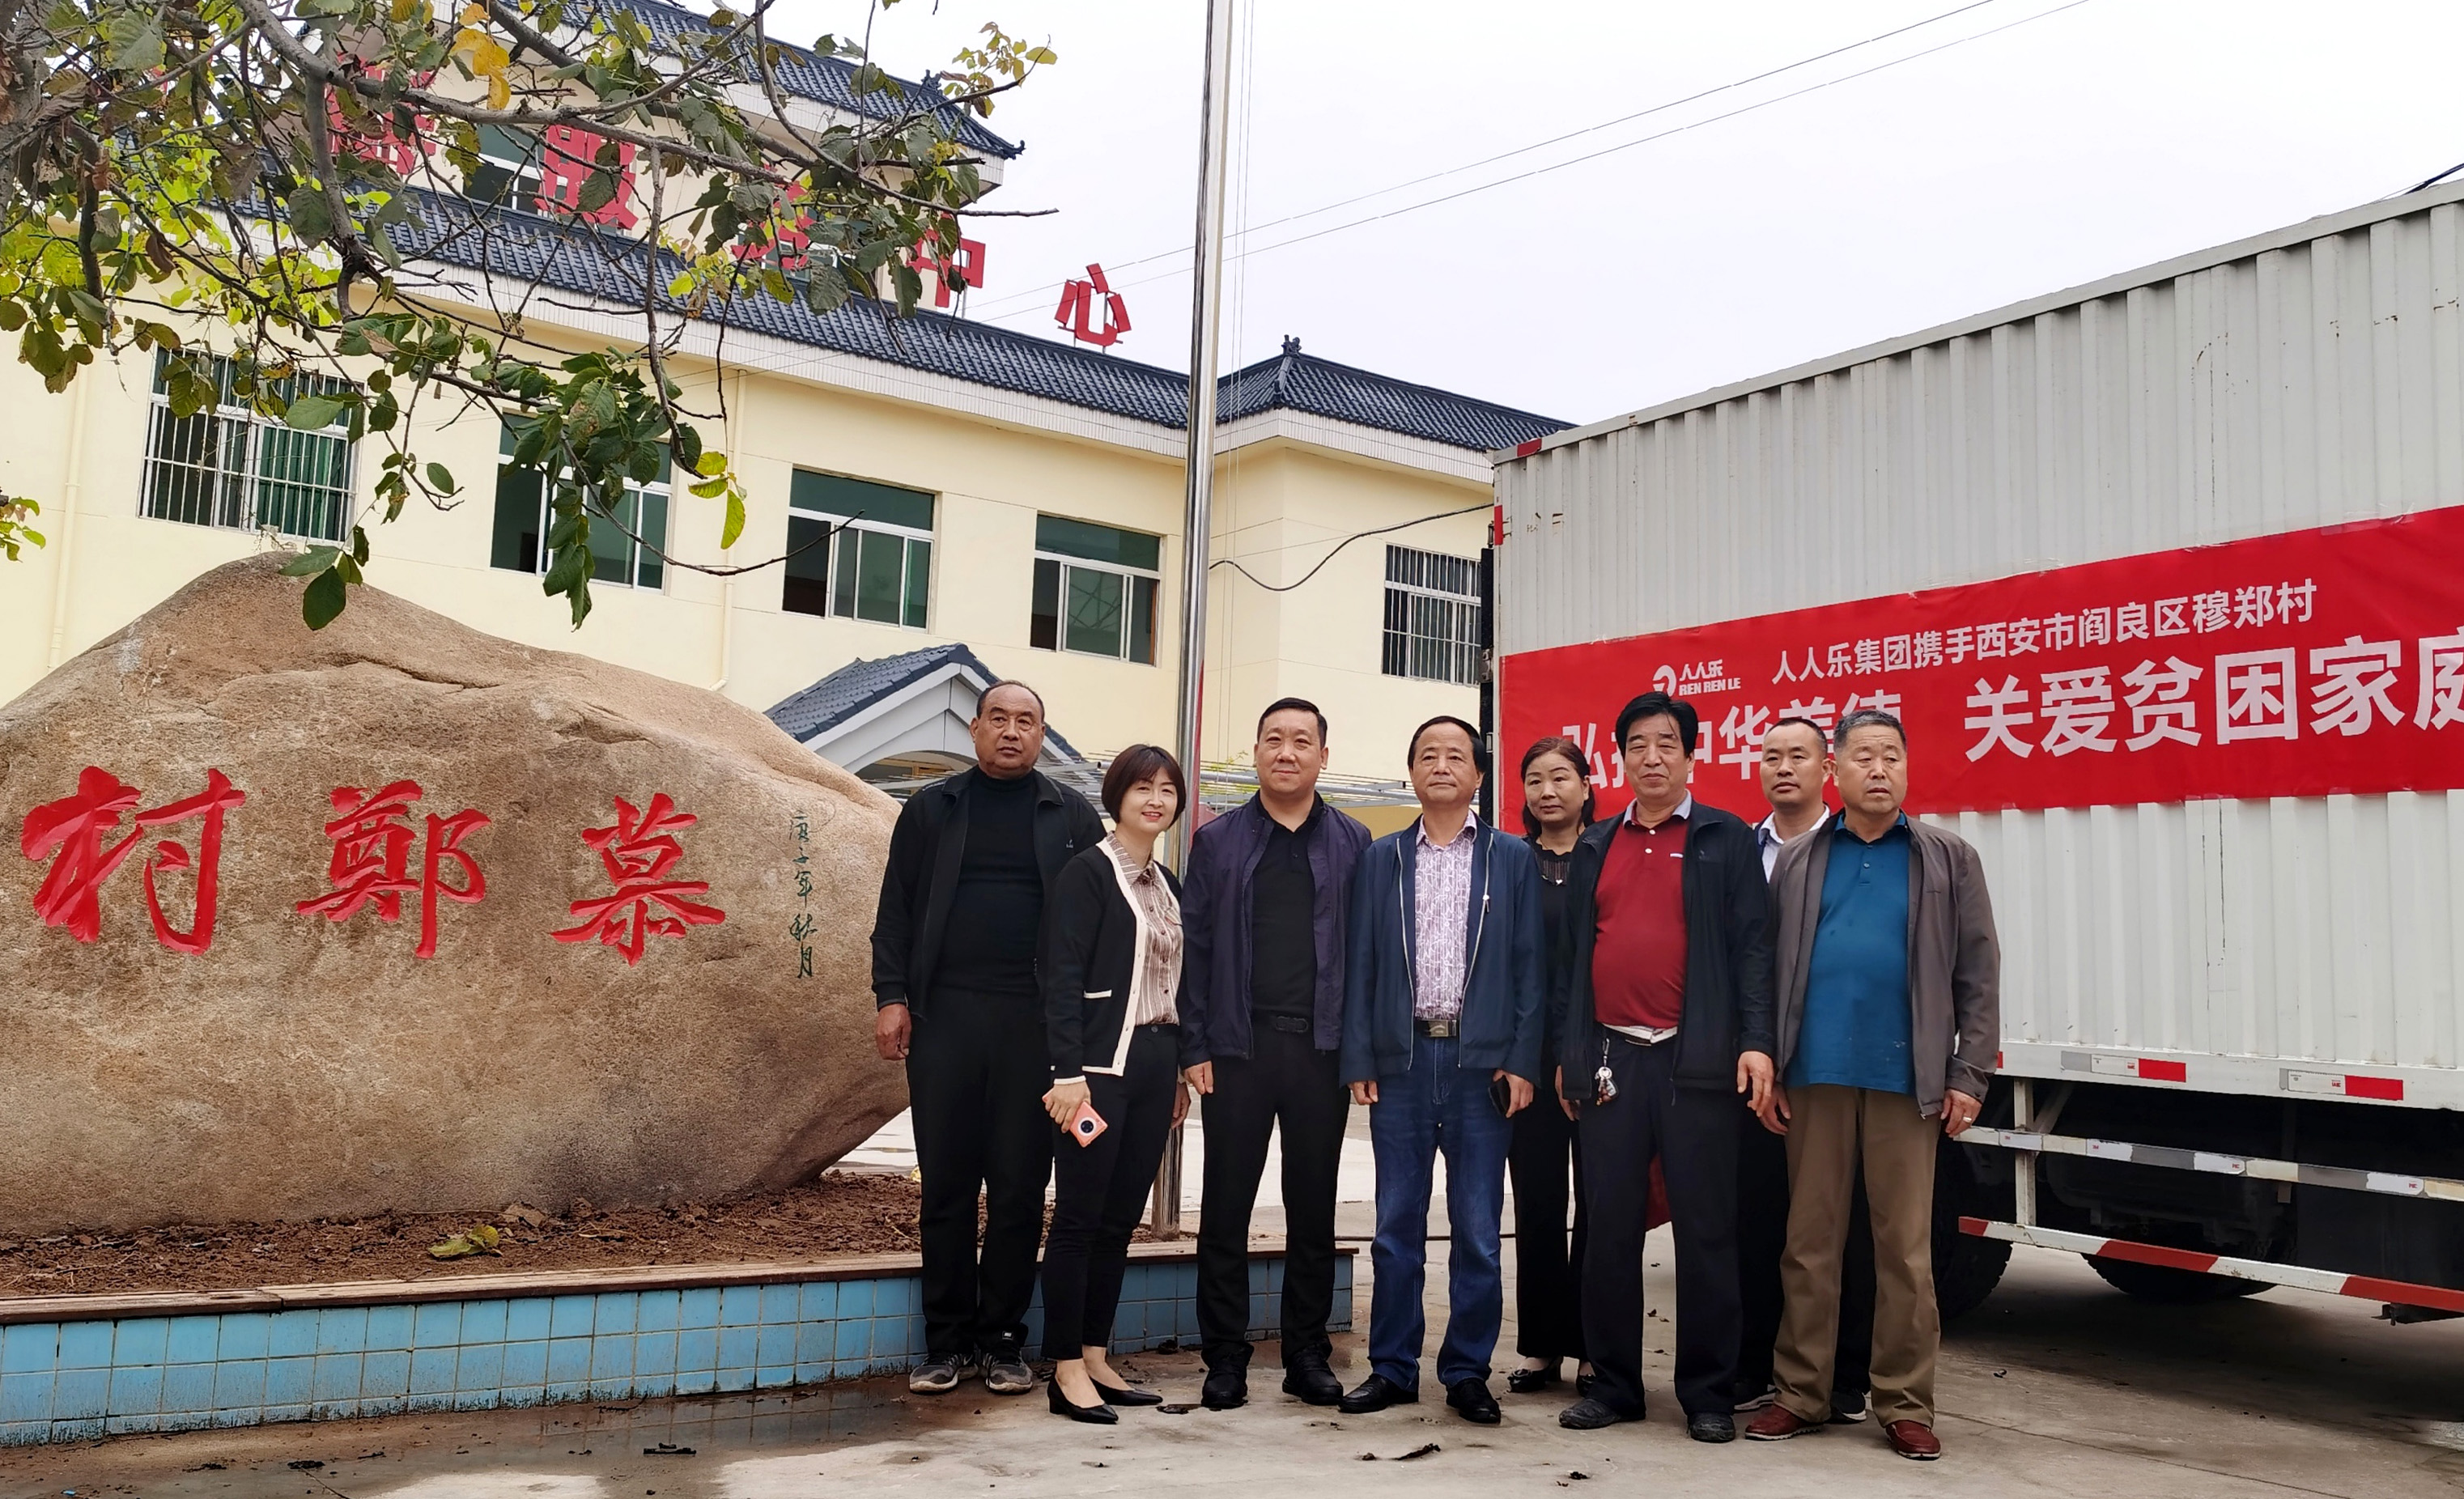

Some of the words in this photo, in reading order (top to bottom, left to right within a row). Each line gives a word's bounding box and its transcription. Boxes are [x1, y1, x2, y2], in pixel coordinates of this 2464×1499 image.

[1772, 578, 2317, 685] 人人乐集团携手西安市阎良区穆郑村
[1679, 659, 1723, 682] 人人乐
[1678, 682, 1701, 696] REN
[1703, 679, 1727, 693] REN
[1727, 677, 1741, 690] LE
